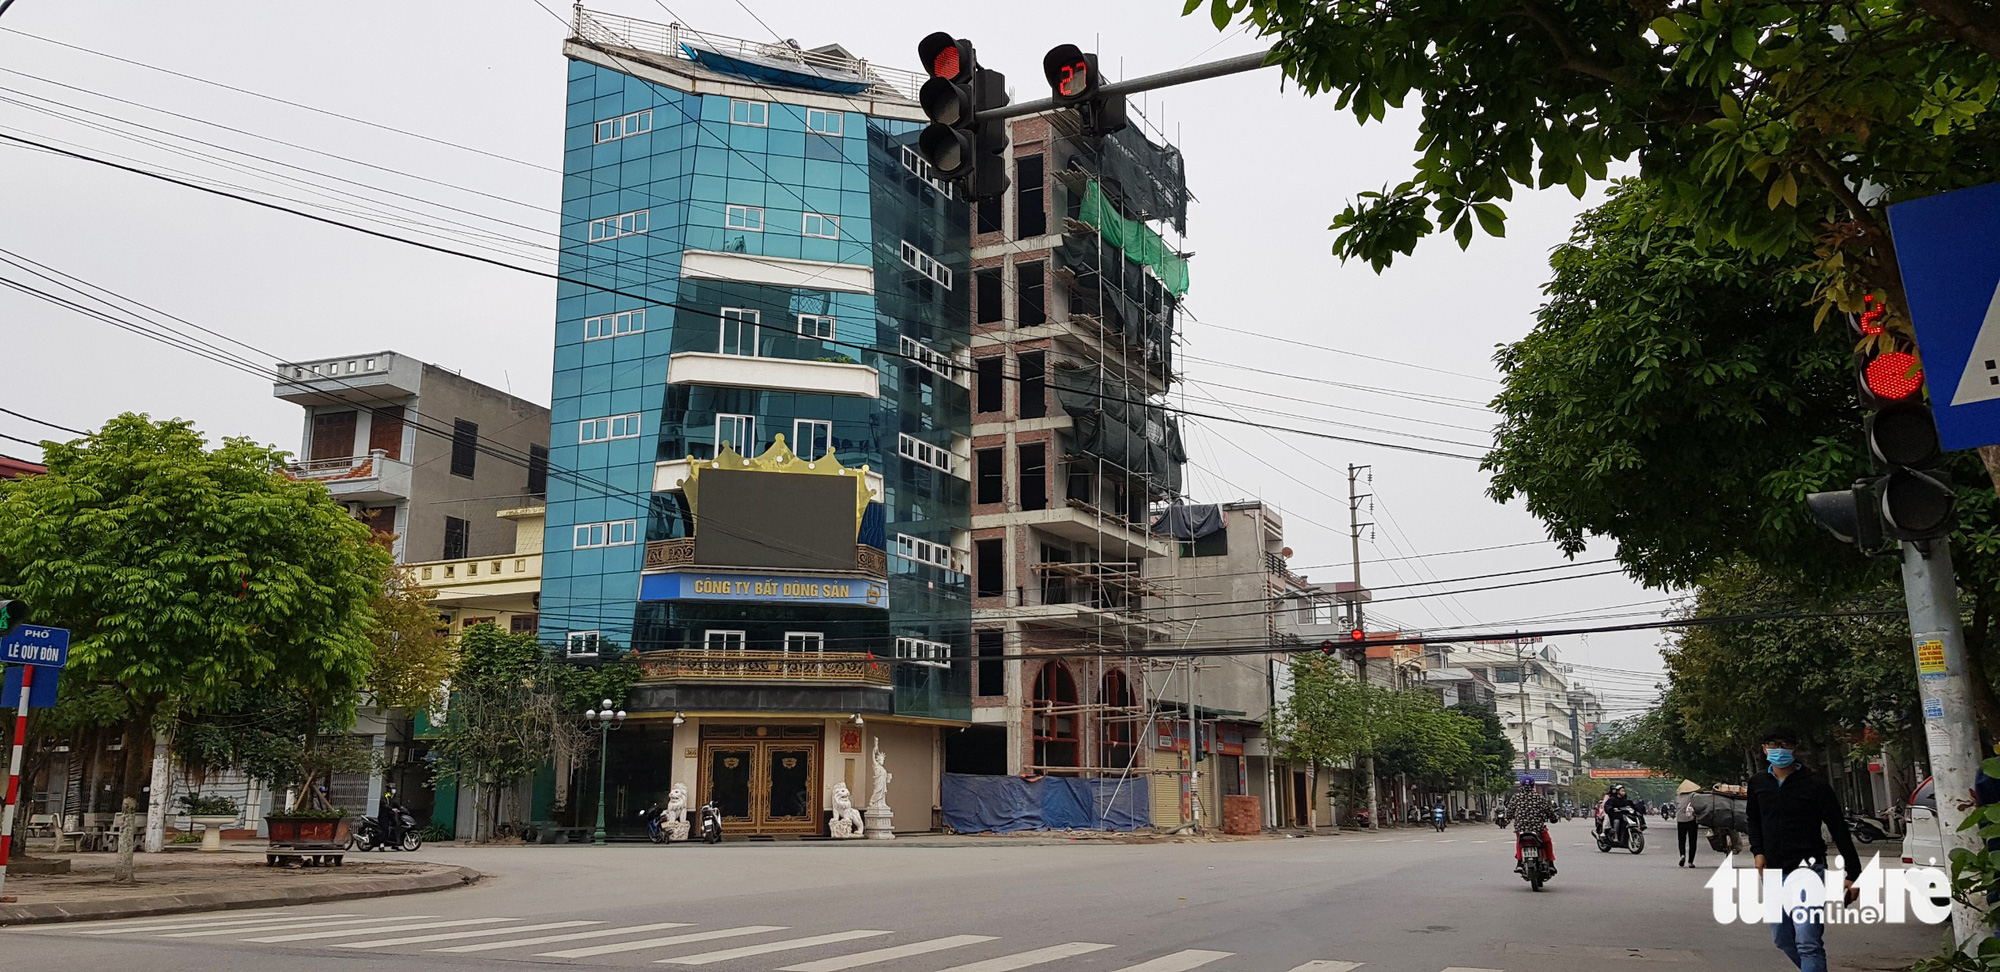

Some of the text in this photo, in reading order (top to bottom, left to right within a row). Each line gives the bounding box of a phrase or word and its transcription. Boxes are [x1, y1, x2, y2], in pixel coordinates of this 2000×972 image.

[1060, 62, 1087, 96] 27
[694, 577, 849, 599] CÔNG TY BẤT ĐỘNG SẢN
[24, 629, 51, 638] PHỐ
[8, 641, 20, 658] LÊ
[40, 645, 59, 662] ĐÔN
